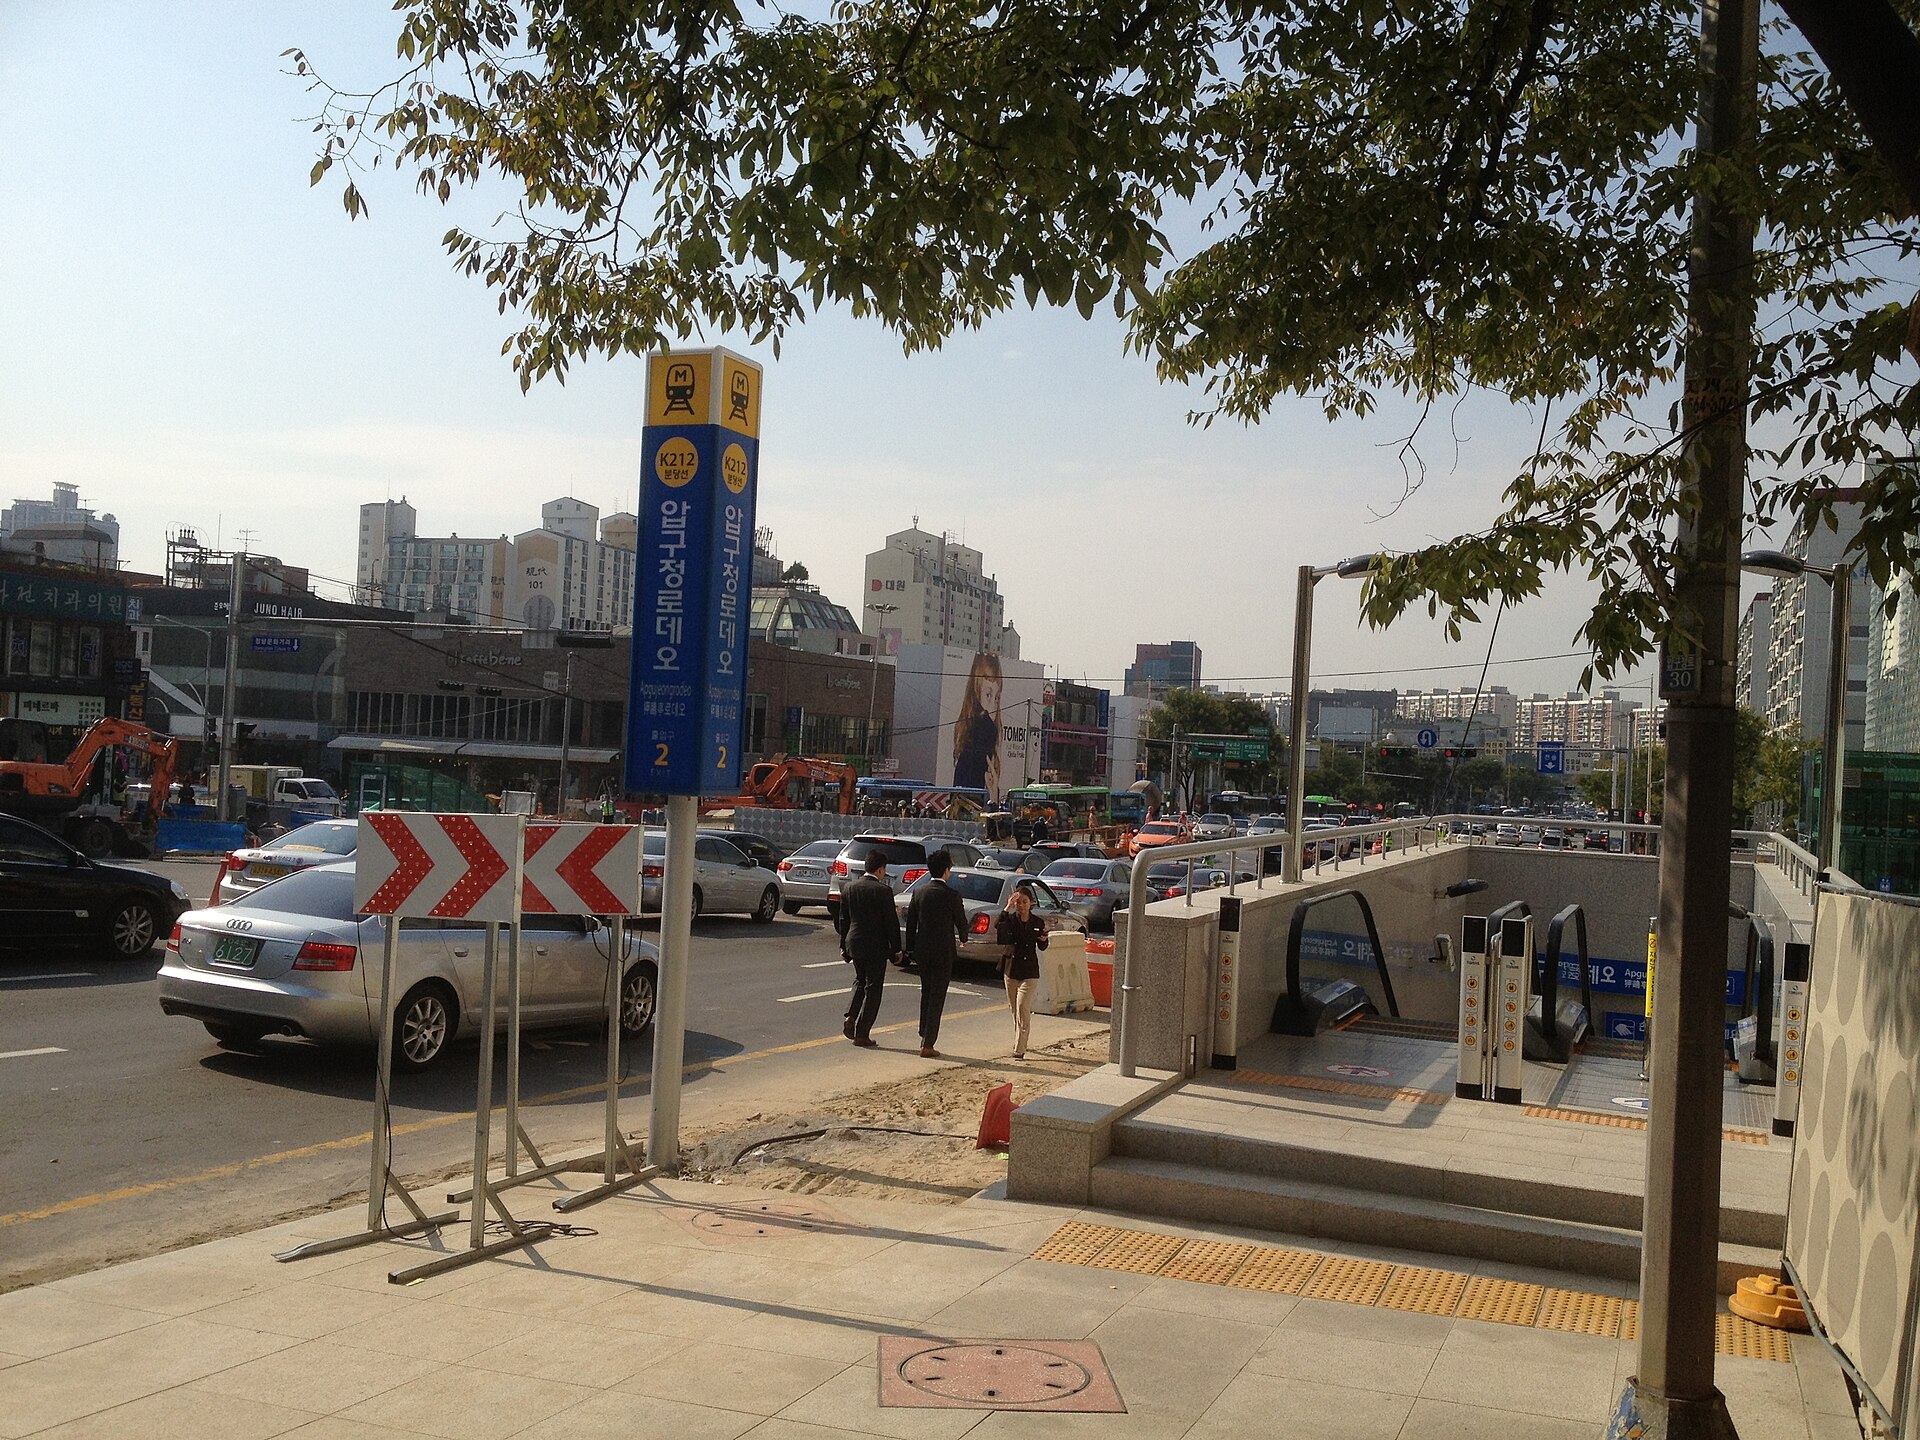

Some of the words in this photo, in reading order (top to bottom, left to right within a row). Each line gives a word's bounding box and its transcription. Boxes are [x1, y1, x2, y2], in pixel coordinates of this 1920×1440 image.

[674, 370, 687, 382] M
[736, 376, 746, 391] M
[659, 453, 695, 468] K212
[724, 455, 747, 476] K212
[664, 469, 690, 480] 분당선
[727, 473, 743, 488] 분당선
[529, 581, 543, 590] 101
[653, 499, 692, 671] 압구정로데오
[717, 503, 744, 676] 압구정로데오
[885, 579, 906, 592] 대원
[254, 602, 277, 616] JUNO
[281, 605, 303, 618] HAIR
[1669, 671, 1691, 688] 30
[654, 743, 669, 766] 2
[716, 745, 727, 769] 2
[215, 944, 253, 964] 6127
